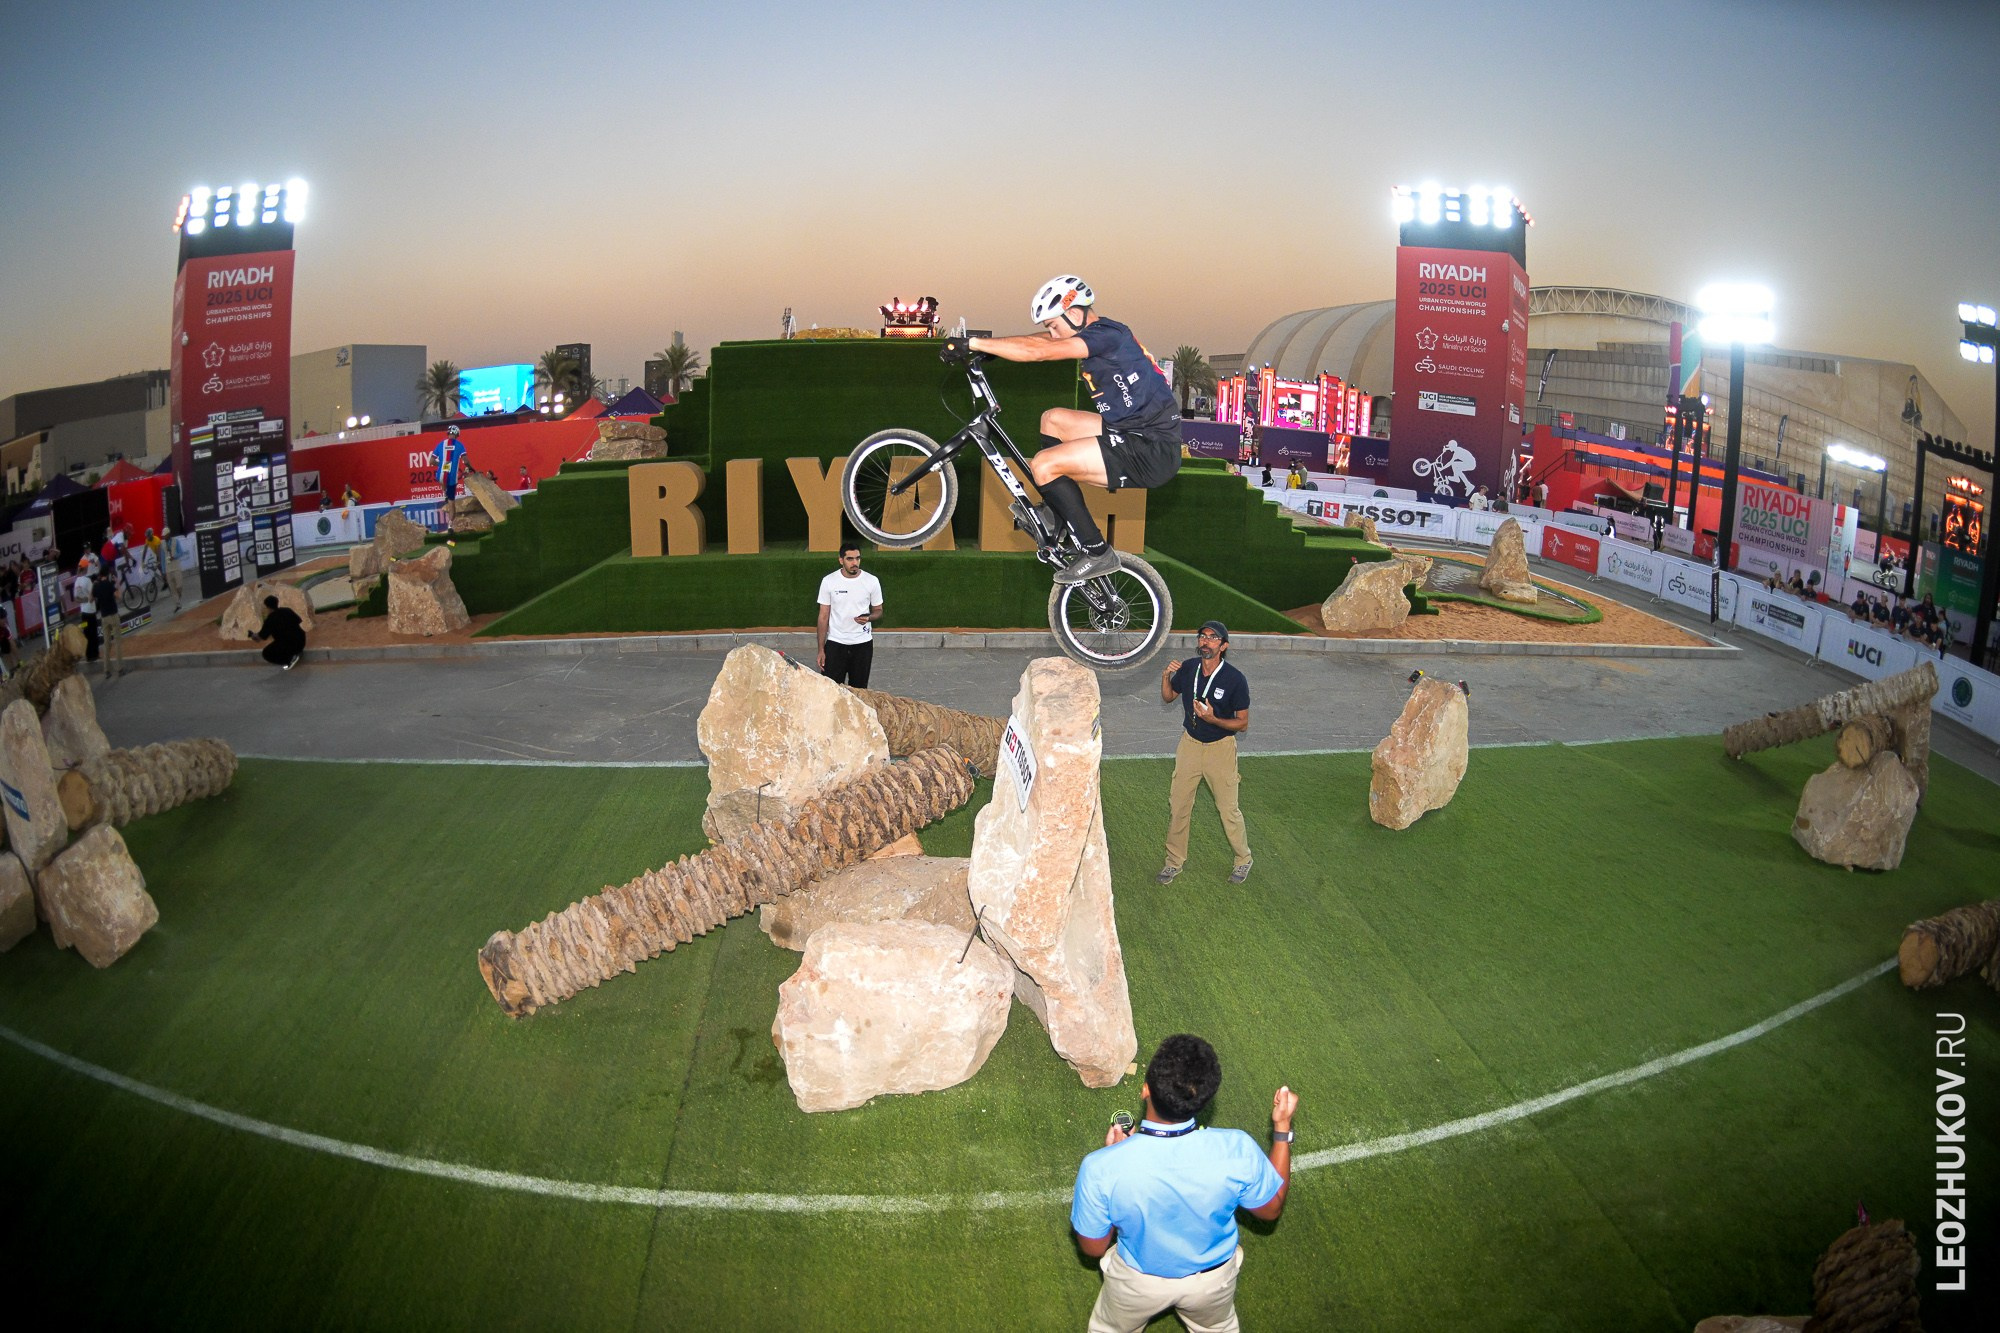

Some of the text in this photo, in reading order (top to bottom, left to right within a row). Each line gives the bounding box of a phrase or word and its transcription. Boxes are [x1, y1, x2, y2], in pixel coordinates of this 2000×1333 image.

[207, 266, 274, 289] RIYADH
[1419, 262, 1486, 283] RIYADH
[207, 287, 273, 306] 2025 UCI
[1419, 281, 1487, 299] 2025 UCI
[1439, 298, 1465, 306] CYCLING
[1465, 300, 1487, 308] WORLD
[206, 308, 226, 316] URBAN
[1418, 304, 1486, 316] CHAMPIONSHIPS
[205, 311, 272, 325] CHAMPIONSHIPS
[1442, 333, 1487, 346] وزارة الرياضة
[1442, 342, 1464, 353] Ministry
[1470, 344, 1487, 353] Sport
[1438, 363, 1457, 371] SAUDI
[1458, 366, 1485, 375] CYCLING
[1113, 374, 1133, 408] Cofidis
[1422, 393, 1437, 401] UCI
[243, 445, 260, 454] FINISH
[409, 451, 434, 468] RIY
[220, 464, 231, 472] UCI
[1743, 485, 1811, 521] RIYADH
[1742, 506, 1810, 539] 2025 UCI
[1740, 522, 1807, 546] URBAN CYCLING WORLD
[260, 543, 272, 551] UCI
[280, 538, 291, 547] UCI
[1738, 532, 1805, 558] CHAMPIONSHIPS
[227, 556, 238, 565] UCI
[1953, 556, 1979, 572] RIYADH
[1640, 565, 1653, 576] وزارة
[47, 585, 56, 603] 5
[1688, 585, 1704, 596] SAUDI
[1754, 601, 1768, 613] UCI
[130, 616, 143, 628] UCI
[1854, 641, 1882, 666] UCI
[1015, 739, 1032, 792] TISSOT
